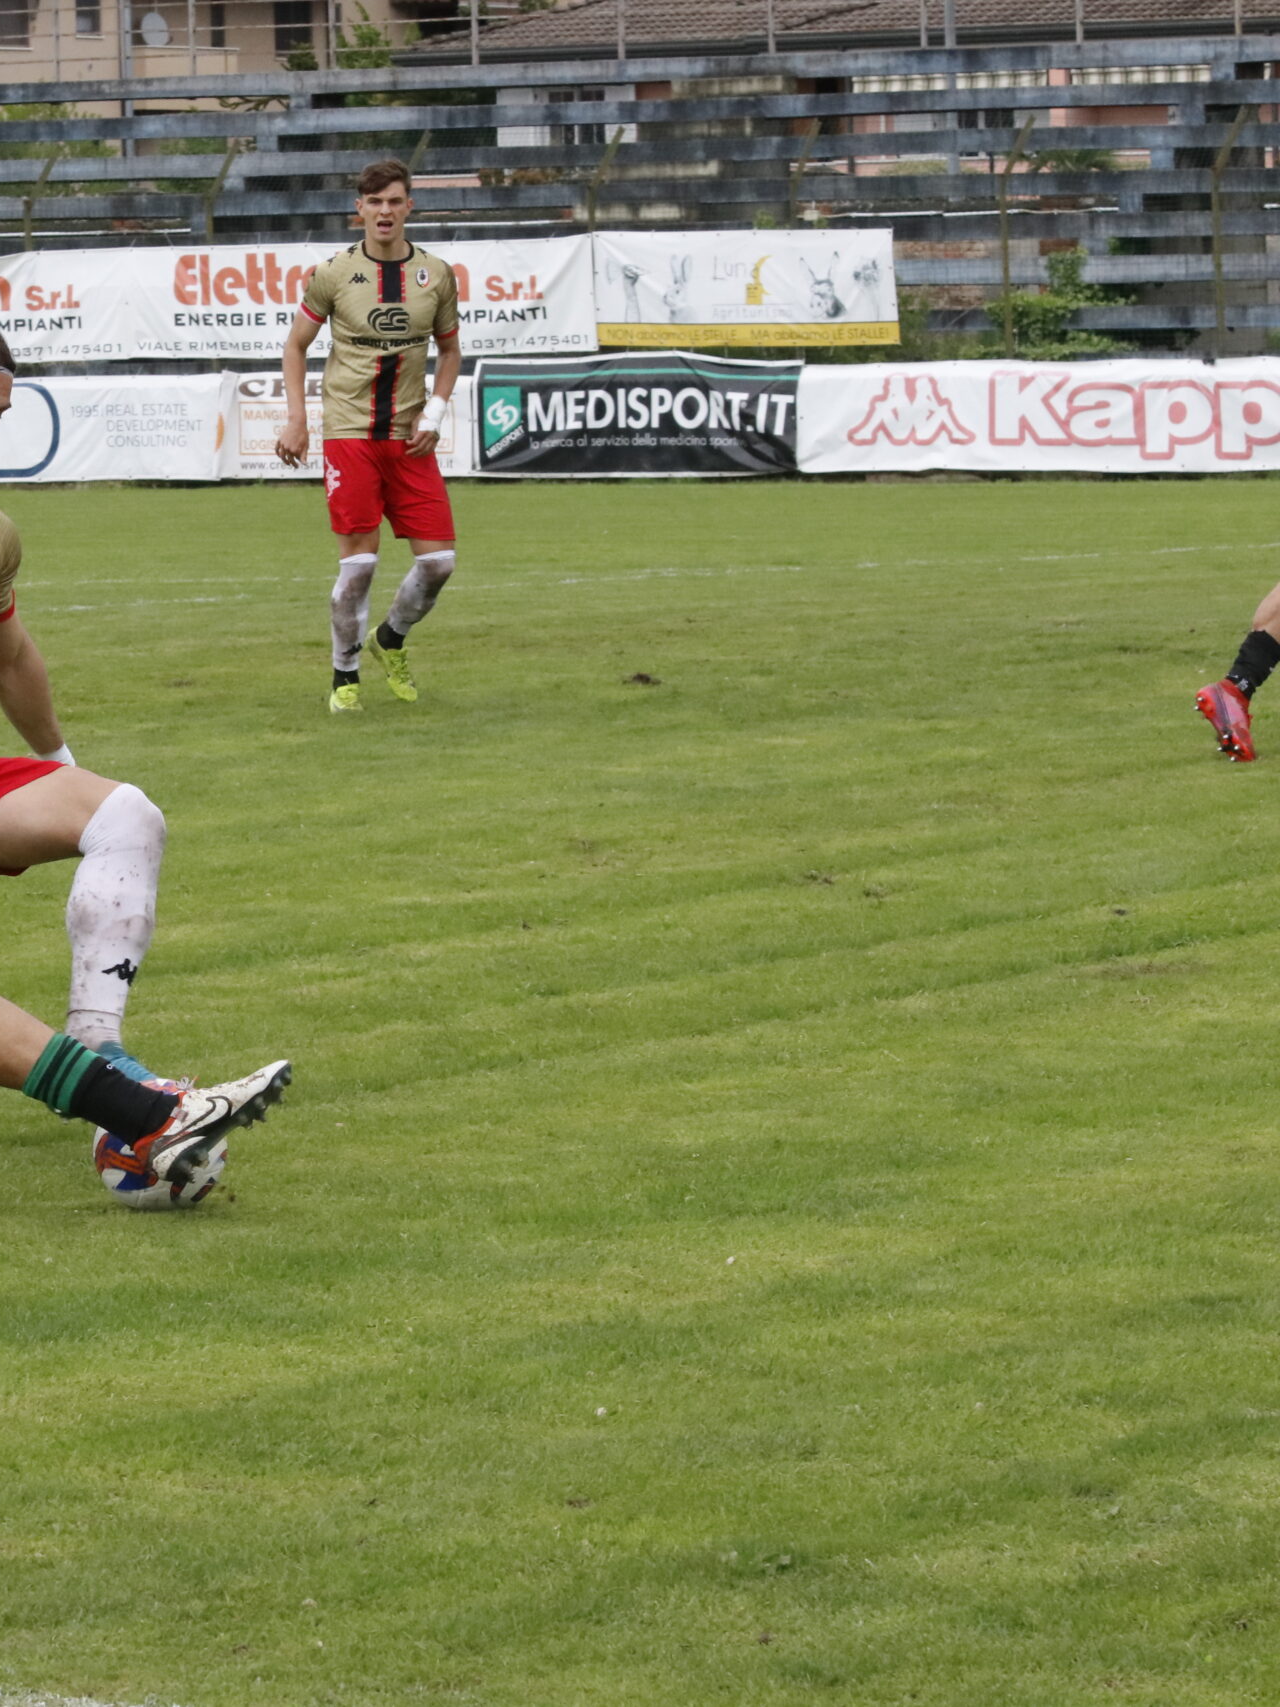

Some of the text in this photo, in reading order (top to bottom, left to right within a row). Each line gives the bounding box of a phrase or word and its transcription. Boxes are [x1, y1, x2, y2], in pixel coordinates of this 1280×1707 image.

[175, 313, 267, 326] ENERGIE
[458, 306, 547, 323] MPIANTI
[137, 341, 183, 351] VIALE
[105, 403, 138, 417] REAL
[142, 403, 189, 416] ESTATE
[527, 387, 795, 436] MEDISPORT.IT
[106, 419, 204, 432] DEVELOPMENT
[106, 435, 188, 448] CONSULTING
[632, 432, 657, 446] della
